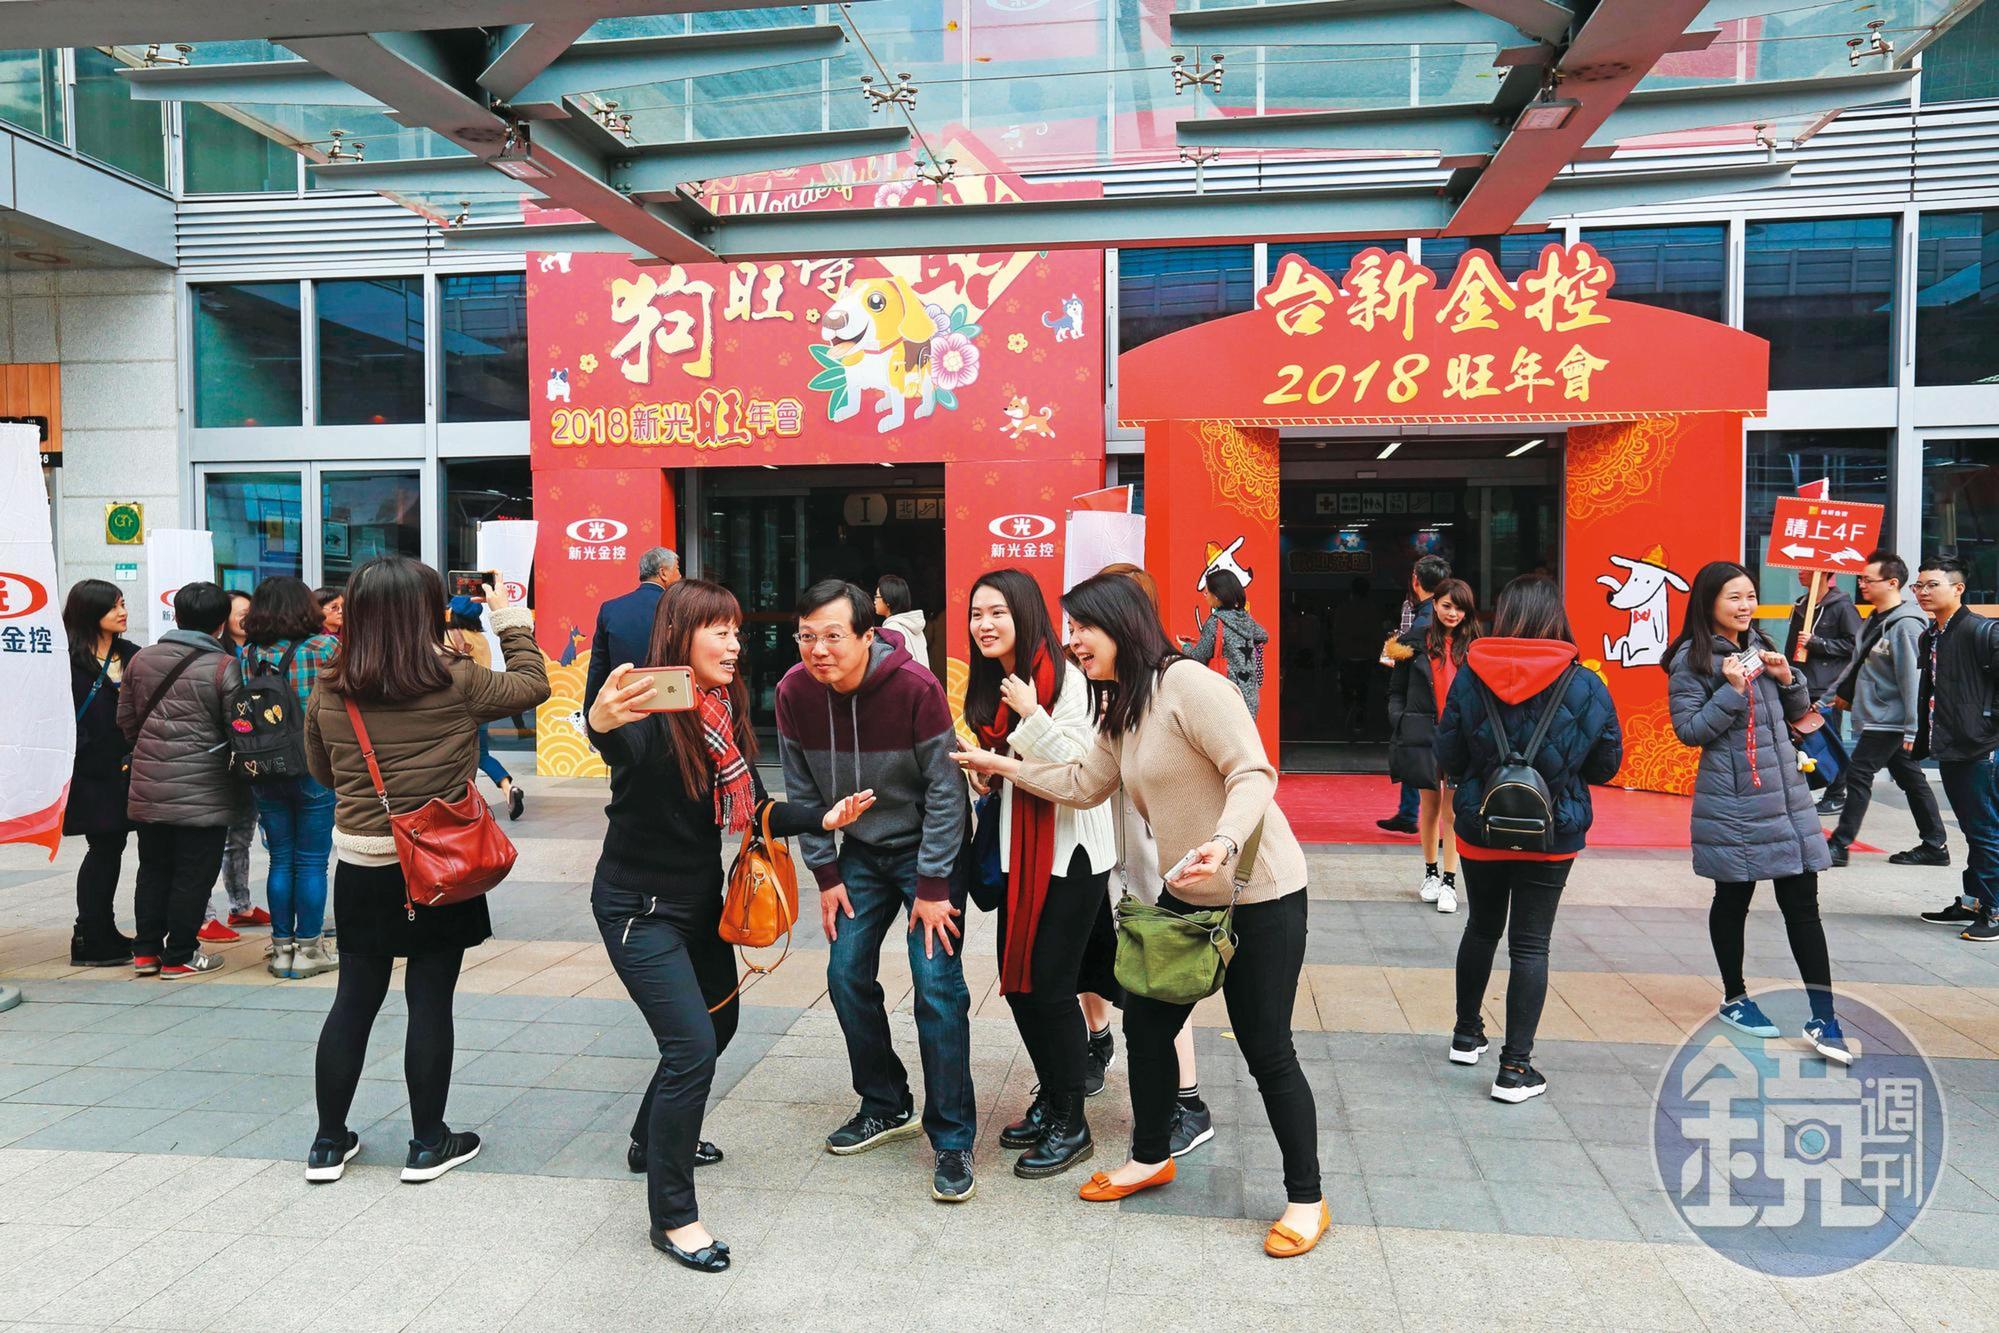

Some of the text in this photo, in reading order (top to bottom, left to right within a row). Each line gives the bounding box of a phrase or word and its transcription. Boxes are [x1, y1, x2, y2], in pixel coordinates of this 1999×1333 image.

[1263, 248, 1612, 341] 台新金控
[1784, 517, 1867, 541] 請上4F
[568, 546, 627, 561] 新光金控
[990, 542, 1054, 558] 新光金控
[1, 626, 52, 654] 金控
